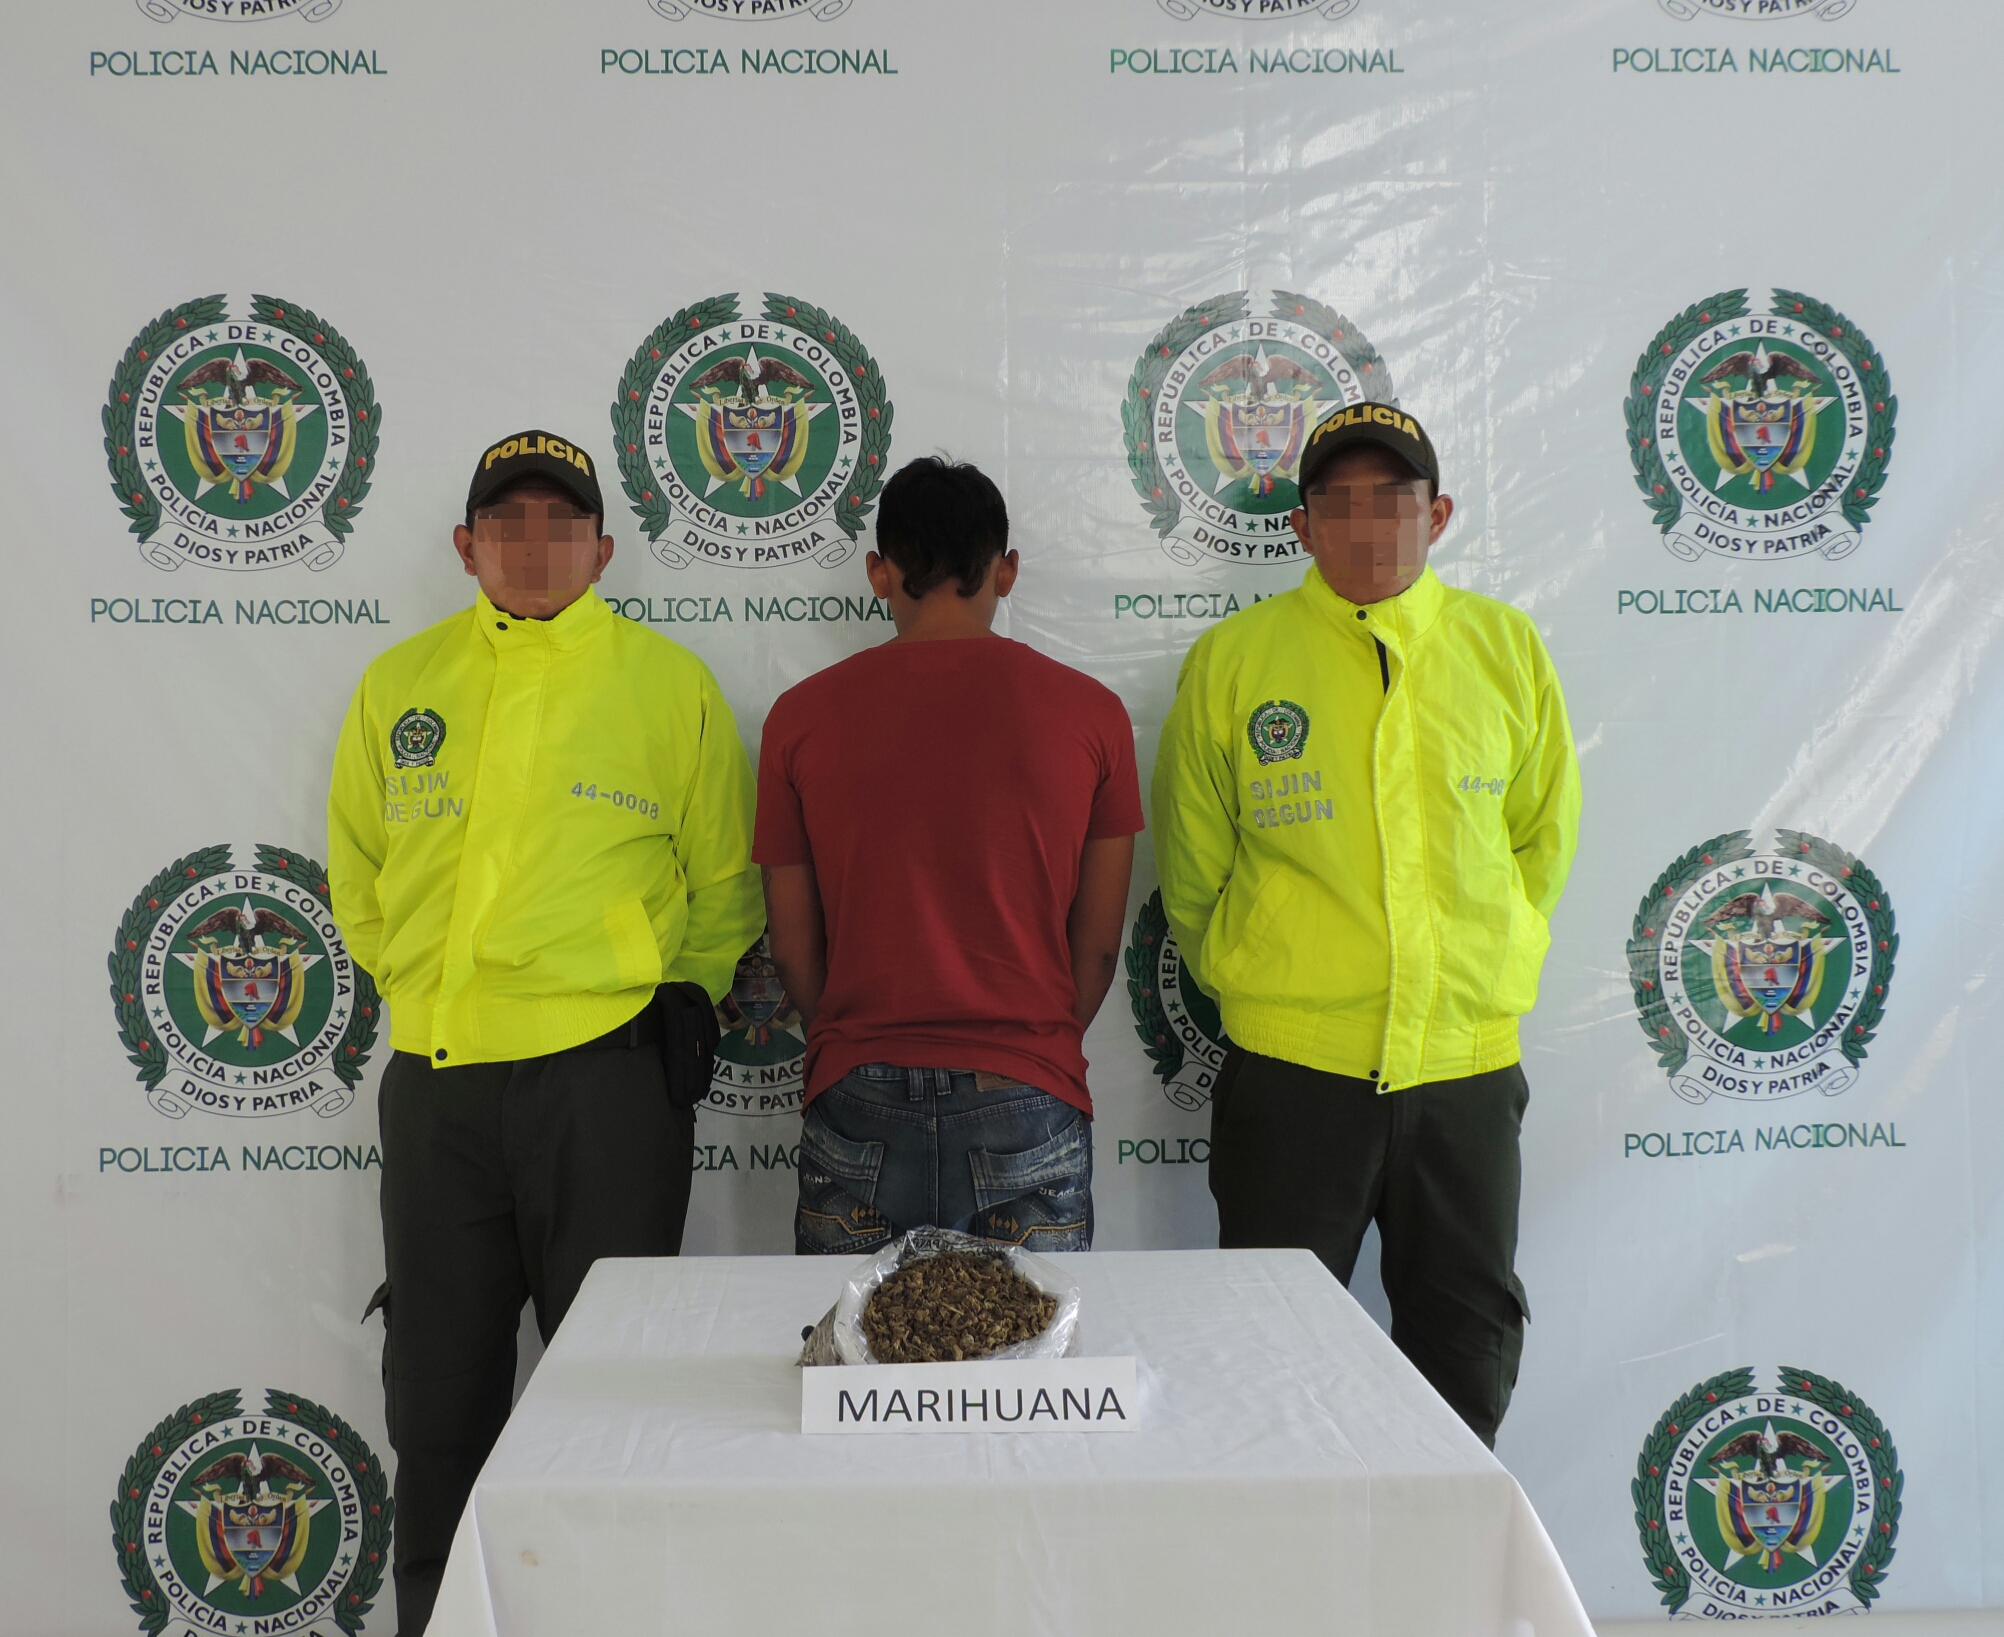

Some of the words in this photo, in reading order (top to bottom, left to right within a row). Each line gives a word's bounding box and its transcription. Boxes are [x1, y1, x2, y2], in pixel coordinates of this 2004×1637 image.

[221, 0, 234, 15] Y
[732, 0, 745, 14] Y
[1242, 0, 1253, 13] Y
[1741, 0, 1753, 13] Y
[90, 50, 219, 76] POLICIA
[230, 50, 388, 75] NACIONAL
[601, 49, 730, 74] POLICIA
[742, 49, 898, 74] NACIONAL
[1110, 48, 1238, 74] POLICIA
[1250, 48, 1405, 73] NACIONAL
[1613, 48, 1738, 73] POLICIA
[1750, 47, 1900, 73] NACIONAL
[1250, 322, 1278, 337] DE
[1300, 333, 1361, 403] COLOM
[1749, 319, 1778, 334] DE
[1800, 331, 1864, 439] COLOMBIA
[227, 325, 258, 341] DE
[280, 338, 346, 447] COLOMBIA
[740, 324, 770, 339] DE
[792, 336, 858, 445] COLOMBIA
[1313, 405, 1420, 445] POLICIA
[485, 436, 590, 476] POLICIA
[245, 471, 336, 539] NACIONAL
[755, 470, 848, 536] NACIONAL
[1764, 463, 1855, 528] NACIONAL
[173, 532, 223, 562] DIOS
[224, 549, 239, 564] Y
[245, 533, 314, 565] PATRIA
[682, 530, 732, 559] DIOS
[734, 547, 748, 562] Y
[755, 531, 825, 562] PATRIA
[1193, 527, 1242, 557] DIOS
[1245, 543, 1259, 558] Y
[1264, 540, 1306, 559] PAT
[1694, 523, 1742, 552] DIOS
[1744, 539, 1758, 554] Y
[1764, 523, 1832, 554] PATRIA
[91, 598, 224, 624] POLICIA
[235, 598, 390, 624] NACIONAL
[1114, 594, 1241, 620] POLICIA
[1618, 589, 1743, 614] POLICIA
[1754, 588, 1904, 613] NACIONAL
[570, 781, 659, 820] 44-0008
[1250, 771, 1322, 801] SIJIN
[385, 797, 463, 822] DEGUN
[1253, 799, 1333, 829] DEGUN
[1754, 860, 1783, 875] DE
[1807, 871, 1868, 977] COLOMBIA
[235, 875, 262, 891] DE
[285, 888, 351, 997] COLOMBIA
[1173, 1014, 1224, 1068] POLIC
[1770, 1001, 1856, 1069] NACIONAL
[253, 1019, 344, 1085] NACIONAL
[1702, 1065, 1748, 1094] DIOS
[1751, 1081, 1764, 1095] Y
[1768, 1061, 1831, 1094] PATRIA
[180, 1079, 230, 1109] DIOS
[232, 1096, 247, 1111] Y
[252, 1080, 324, 1112] PATRIA
[709, 1090, 737, 1108] OS
[741, 1095, 754, 1110] Y
[760, 1089, 806, 1110] PATR
[1118, 1138, 1210, 1164] POLIC
[1624, 1129, 1744, 1158] POLICIA
[1756, 1122, 1906, 1151] NACIONAL
[99, 1146, 231, 1173] POLICIA
[242, 1145, 383, 1171] NACIONA
[838, 1386, 1126, 1423] MARIHUANA
[1757, 1398, 1785, 1413] DE
[1809, 1410, 1870, 1515] COLOMBIA
[242, 1420, 271, 1435] DE
[294, 1432, 358, 1542] COLOMBIA
[1772, 1539, 1862, 1607] NACIONAL
[254, 1567, 348, 1635] NACIONAL
